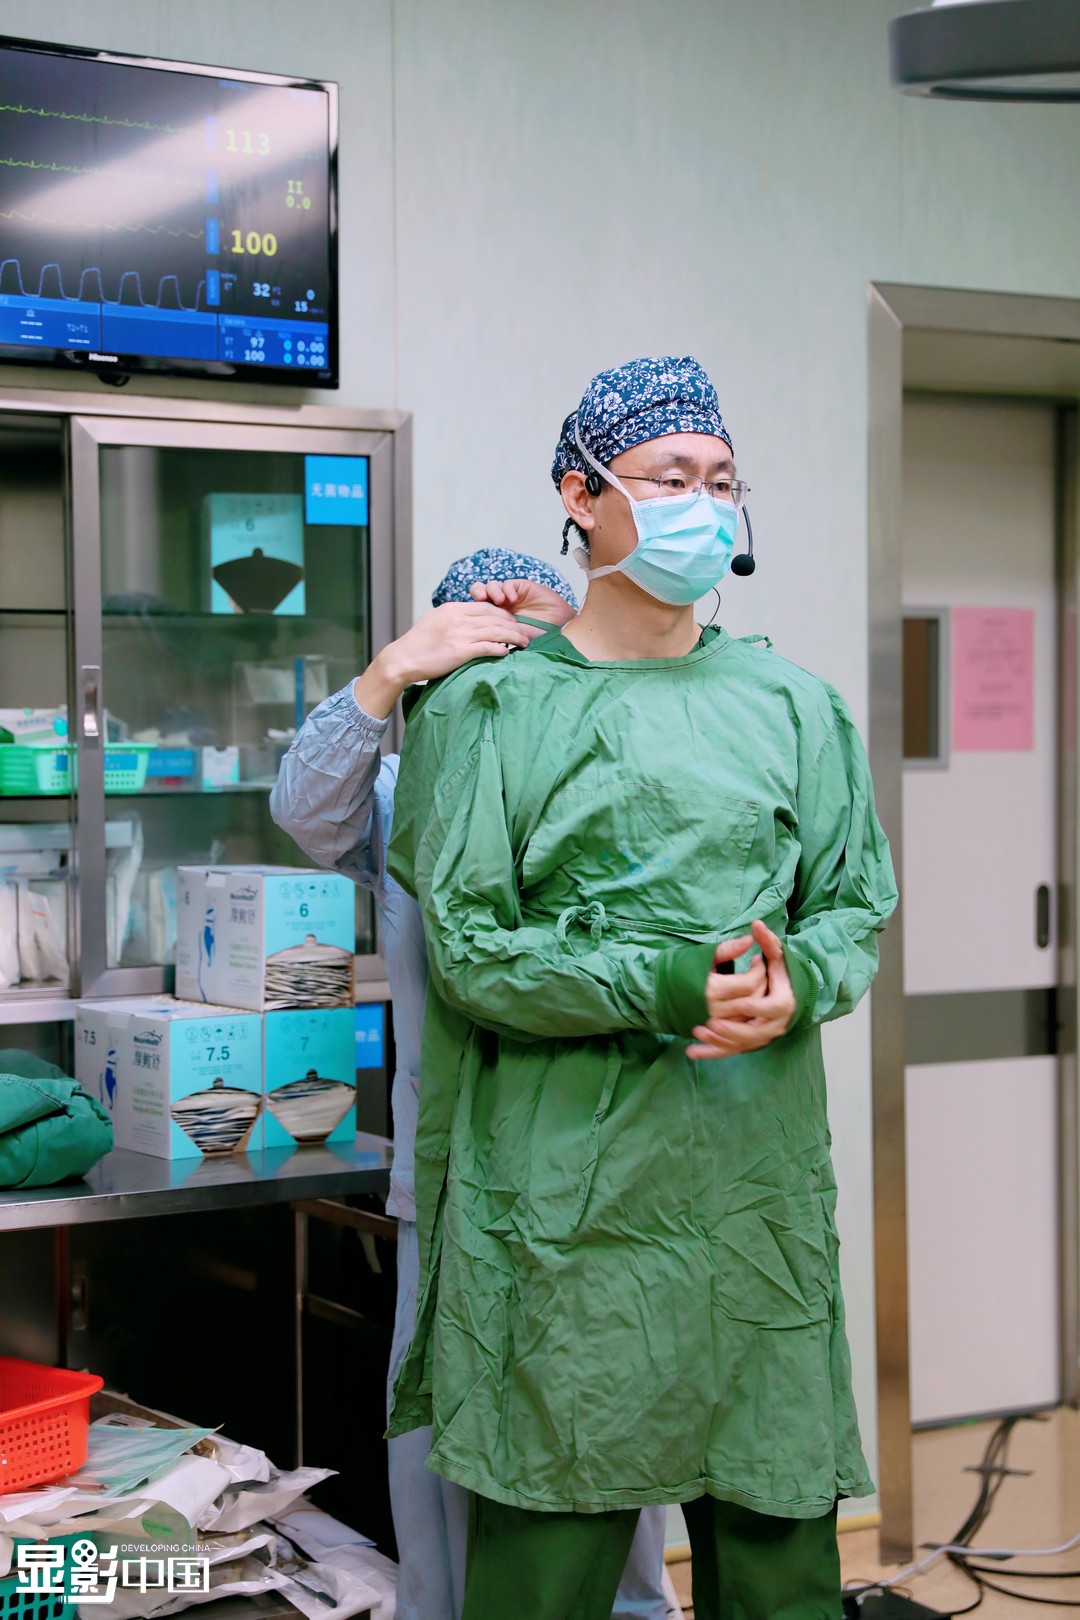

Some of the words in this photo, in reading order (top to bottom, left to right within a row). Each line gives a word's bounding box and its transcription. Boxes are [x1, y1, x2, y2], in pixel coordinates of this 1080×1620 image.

[226, 128, 270, 156] 113
[286, 195, 311, 210] 0.0
[231, 229, 278, 256] 100
[252, 282, 271, 298] 32
[250, 337, 265, 348] 97
[244, 350, 265, 362] 100
[245, 518, 255, 532] 6
[299, 903, 309, 917] 6
[300, 1036, 310, 1052] 7
[206, 1045, 230, 1062] 7.5
